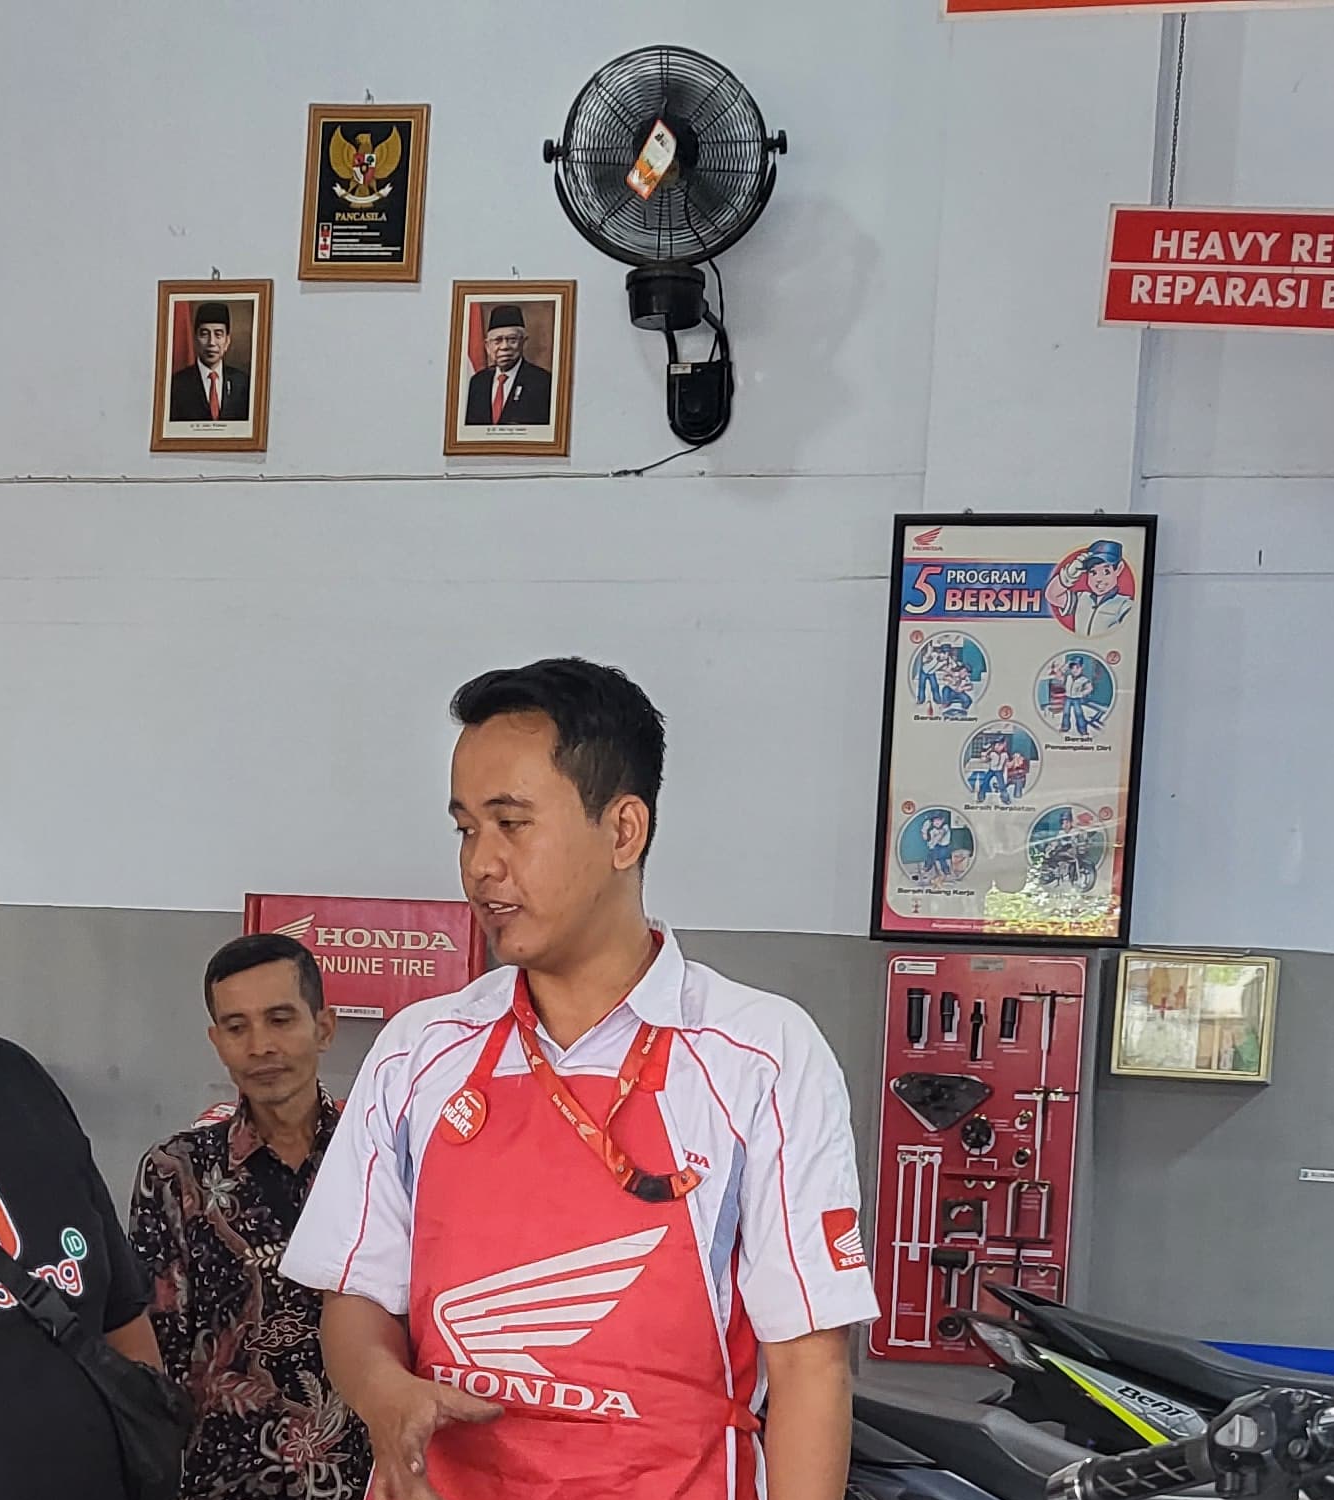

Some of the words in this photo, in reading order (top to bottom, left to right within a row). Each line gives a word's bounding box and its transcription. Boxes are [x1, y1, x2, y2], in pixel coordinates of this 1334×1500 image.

[335, 211, 387, 222] PANCASILA
[1152, 230, 1280, 262] HEAVY
[1130, 274, 1310, 308] REPARASI
[946, 569, 1026, 584] PROGRAM
[904, 564, 943, 614] 5
[944, 588, 1041, 612] BERSIH
[315, 927, 457, 952] HONDA
[392, 958, 436, 977] TIRE
[454, 1096, 473, 1119] One
[67, 1239, 82, 1253] ID
[430, 1364, 642, 1419] HONDA
